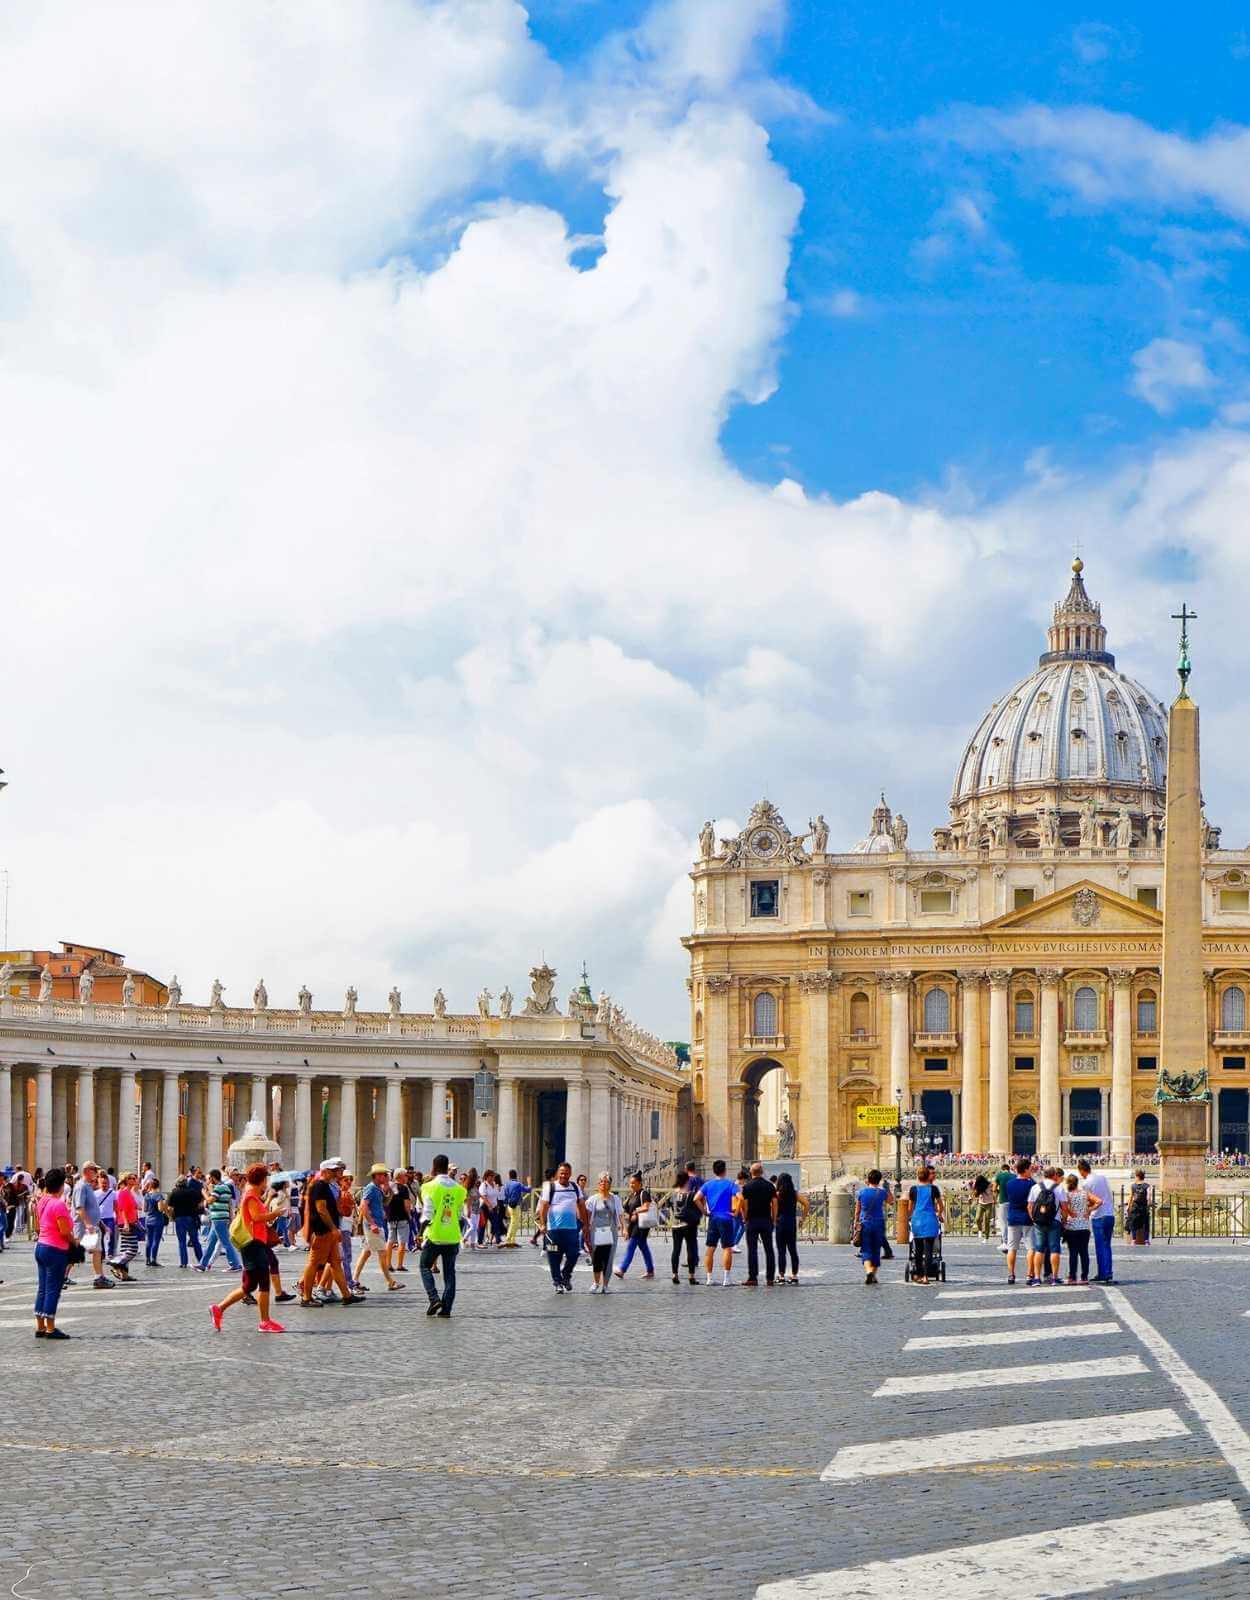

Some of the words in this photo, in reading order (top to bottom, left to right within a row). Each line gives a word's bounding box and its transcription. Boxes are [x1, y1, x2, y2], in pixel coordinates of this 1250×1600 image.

[809, 946, 824, 957] IN
[831, 946, 889, 956] HONOREM
[892, 945, 951, 955] PRINCIPIS
[952, 944, 990, 953] APOST
[991, 942, 1032, 953] PAVLVS
[1043, 942, 1118, 953] BVRGHESIVS
